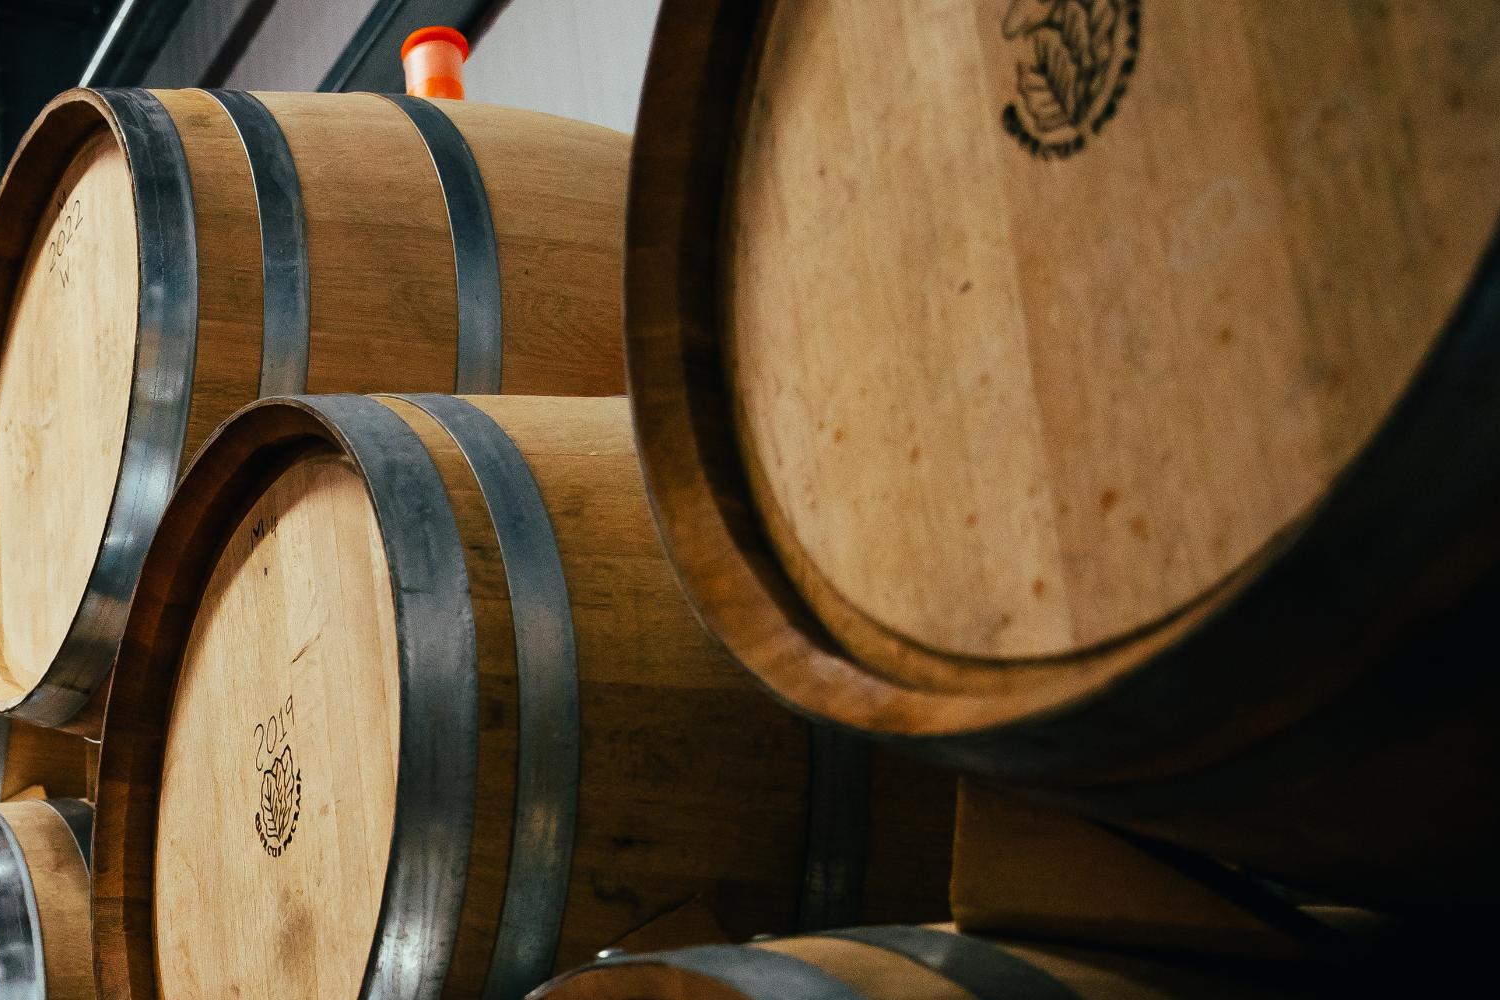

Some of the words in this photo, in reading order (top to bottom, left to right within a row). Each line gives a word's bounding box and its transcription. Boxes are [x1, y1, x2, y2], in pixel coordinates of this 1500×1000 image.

[48, 199, 84, 273] 2022
[60, 256, 70, 288] W
[253, 694, 295, 772] 2019
